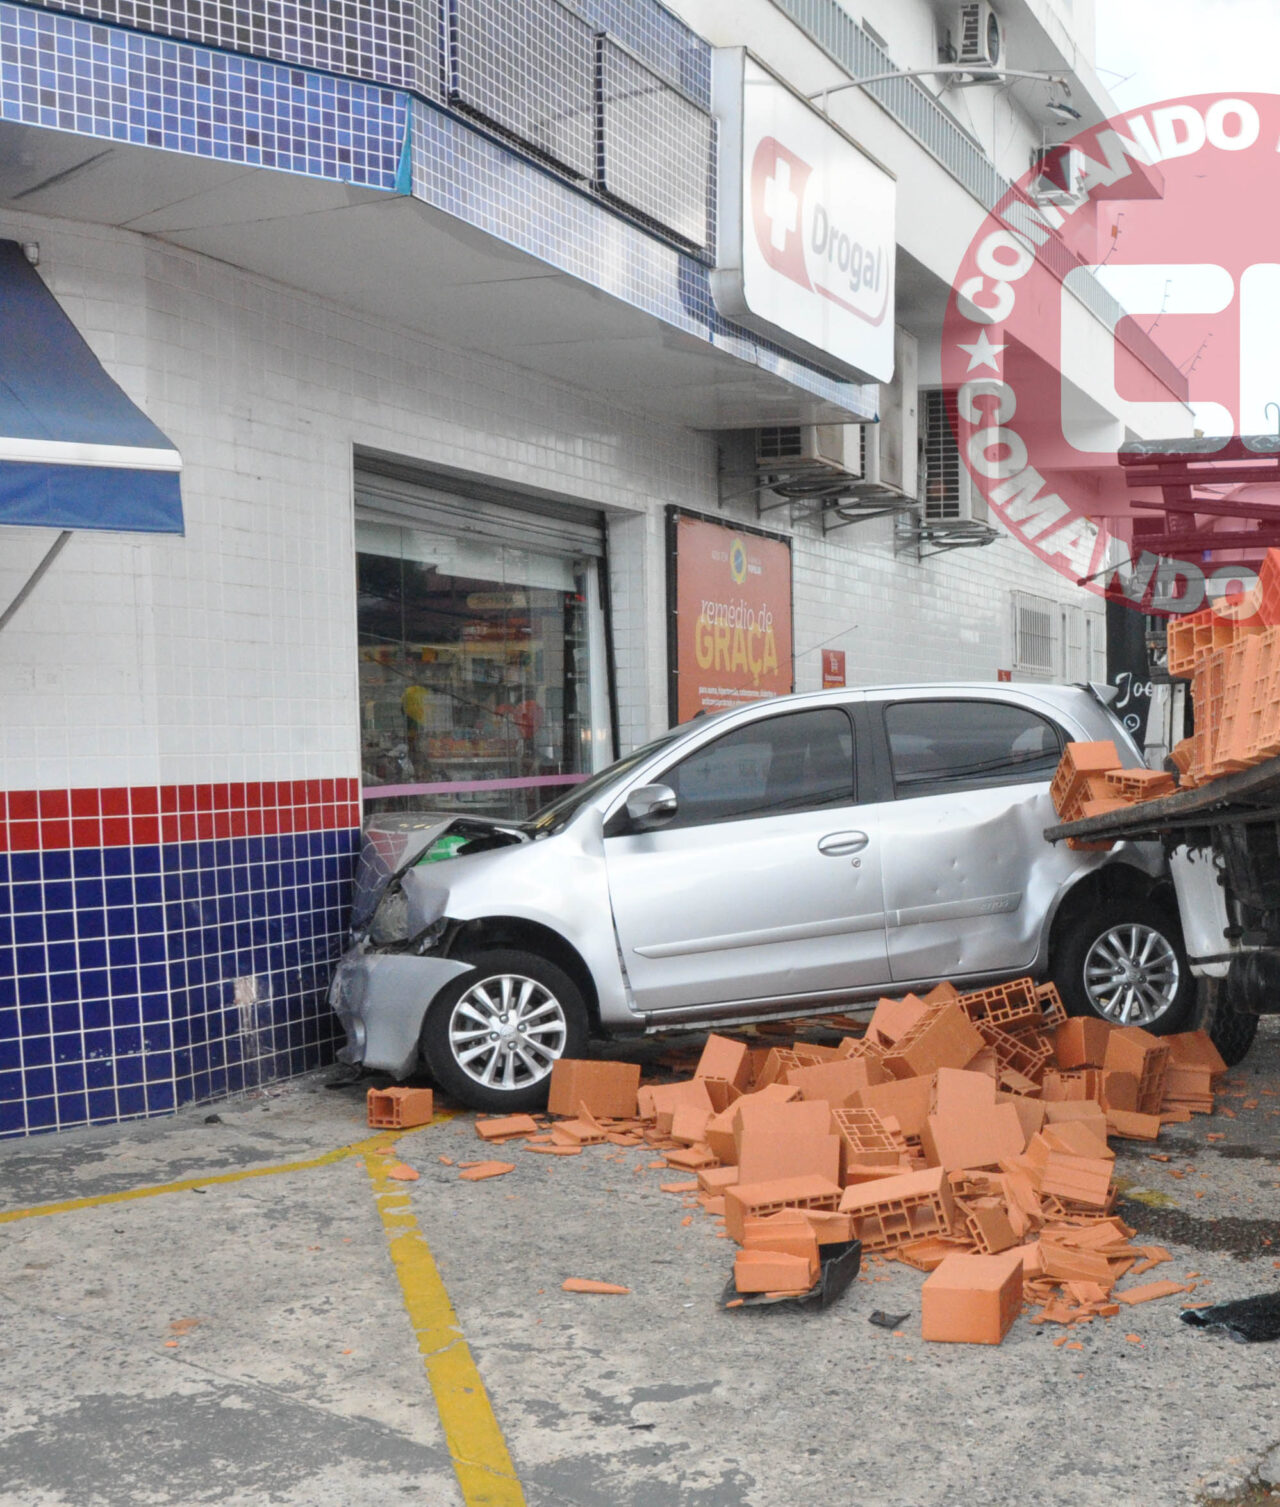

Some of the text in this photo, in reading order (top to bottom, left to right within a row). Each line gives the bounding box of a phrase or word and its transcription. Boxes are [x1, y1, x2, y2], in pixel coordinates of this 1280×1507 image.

[811, 202, 882, 293] Drogal
[695, 613, 778, 687] GRAÇA
[700, 598, 773, 633] remédio de
